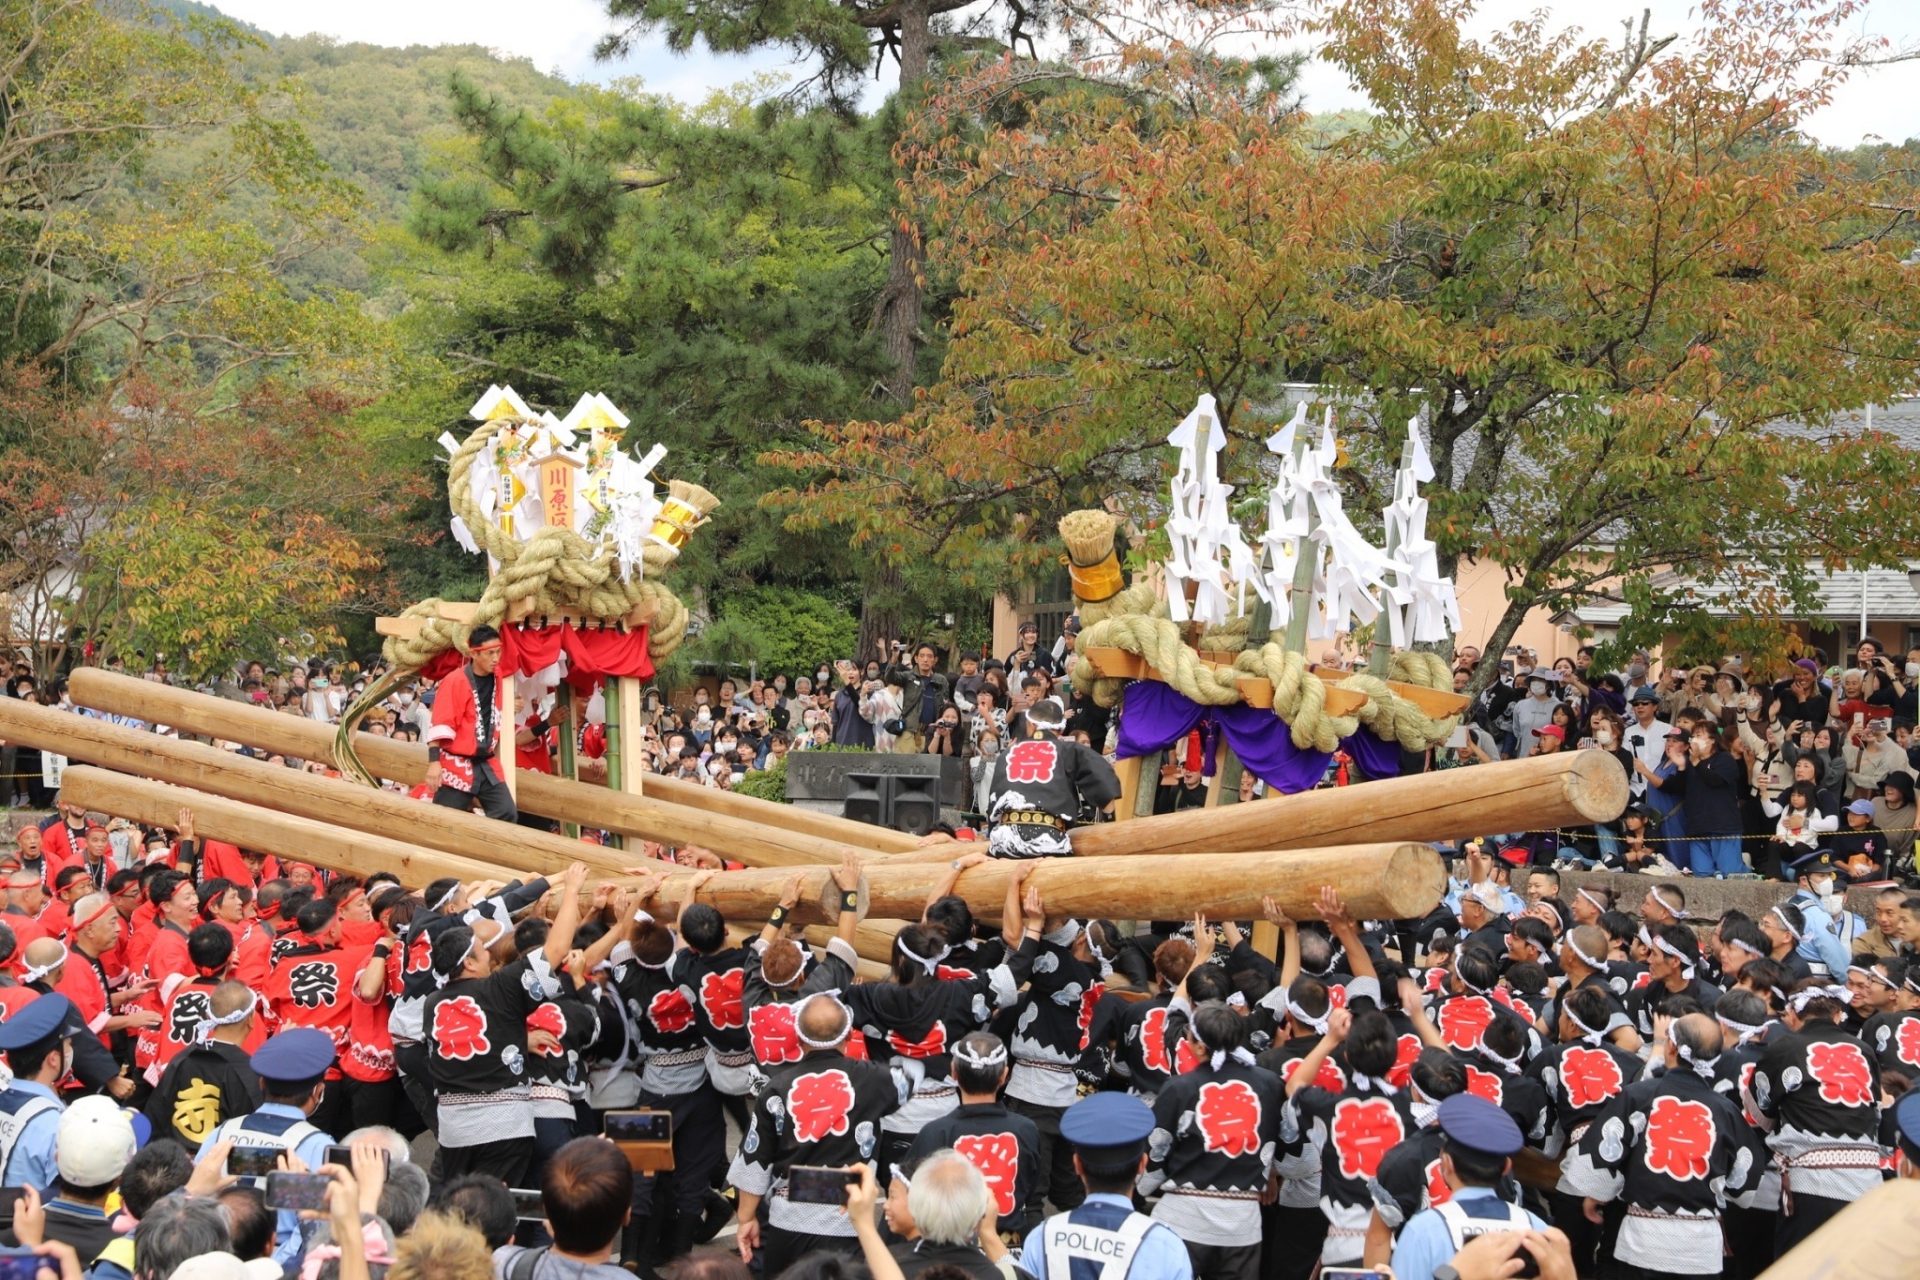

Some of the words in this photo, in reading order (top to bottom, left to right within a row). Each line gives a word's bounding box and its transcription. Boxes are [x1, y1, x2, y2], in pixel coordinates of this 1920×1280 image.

[1006, 741, 1058, 784] 祭
[289, 961, 340, 1009] 祭
[433, 995, 492, 1061] 祭
[787, 1068, 855, 1143] 祭
[1560, 1046, 1623, 1109] 祭
[1806, 1041, 1875, 1109] 祭
[172, 1077, 220, 1143] 寺
[1196, 1079, 1262, 1159] 祭
[1643, 1095, 1717, 1182] 祭
[1055, 1231, 1126, 1259] POLICE
